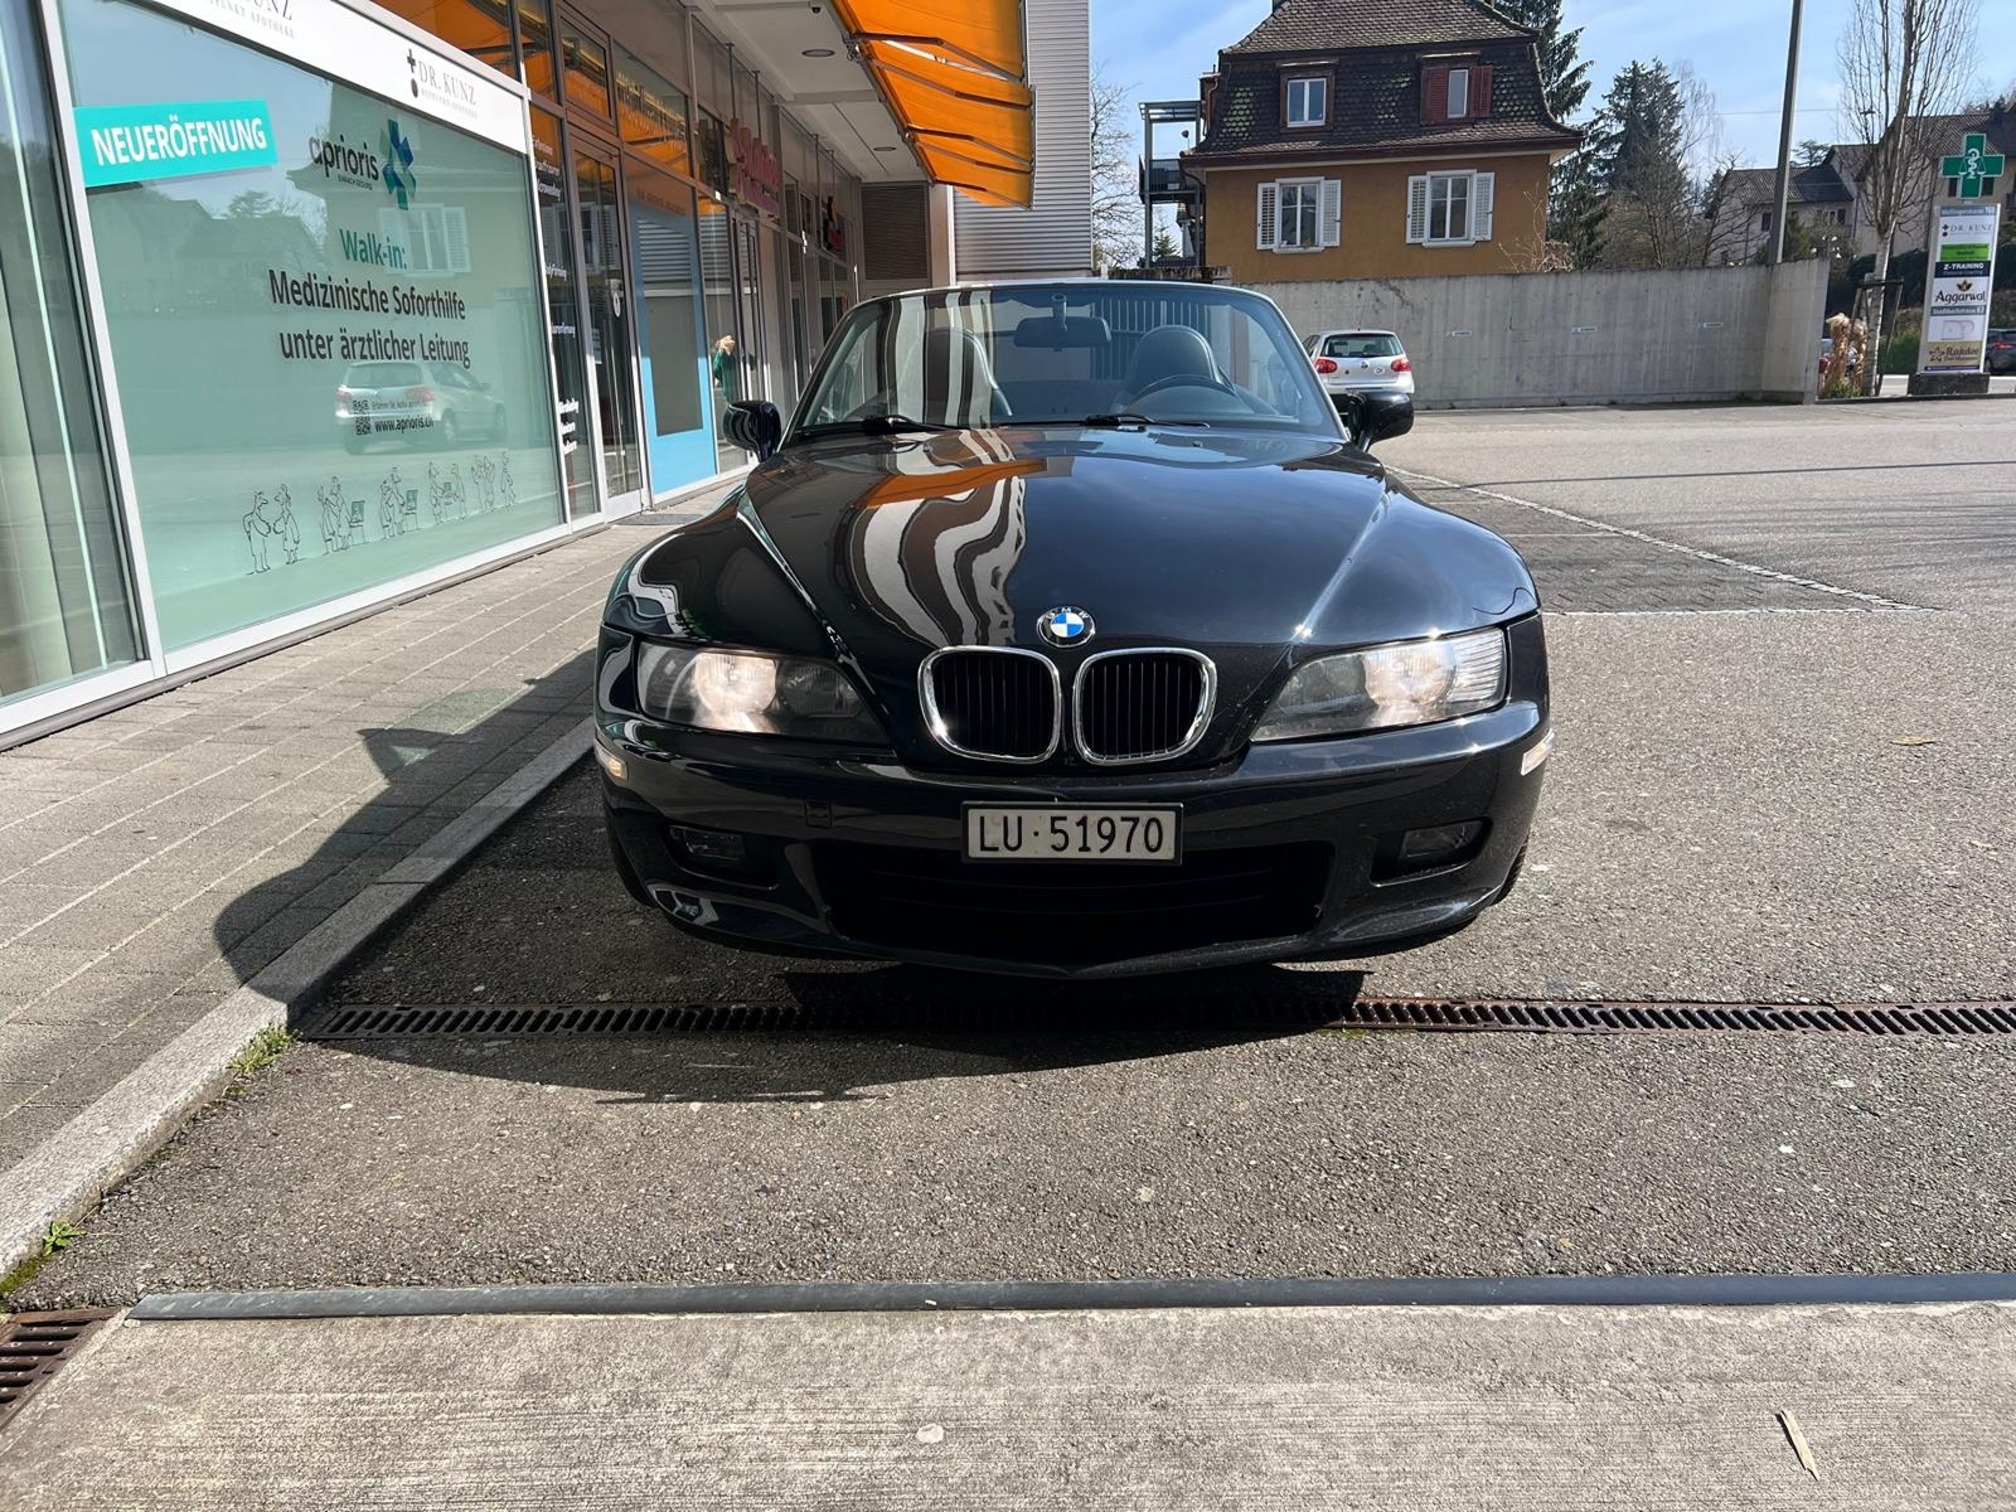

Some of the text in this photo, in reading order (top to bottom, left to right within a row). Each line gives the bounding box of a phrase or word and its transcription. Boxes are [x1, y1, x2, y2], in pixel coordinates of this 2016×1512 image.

[418, 60, 442, 90] DR.
[442, 72, 477, 105] KUNZ
[91, 114, 268, 166] NEUERÖFFNUNG
[309, 133, 379, 180] aprioris
[339, 228, 408, 270] Walk-in:
[1943, 262, 1984, 271] Z-TRAINING
[268, 269, 466, 320] Medizinische Soforthilfe
[1935, 290, 1986, 304] Aggarwal
[279, 327, 471, 369] unter ärztlicher Leitung
